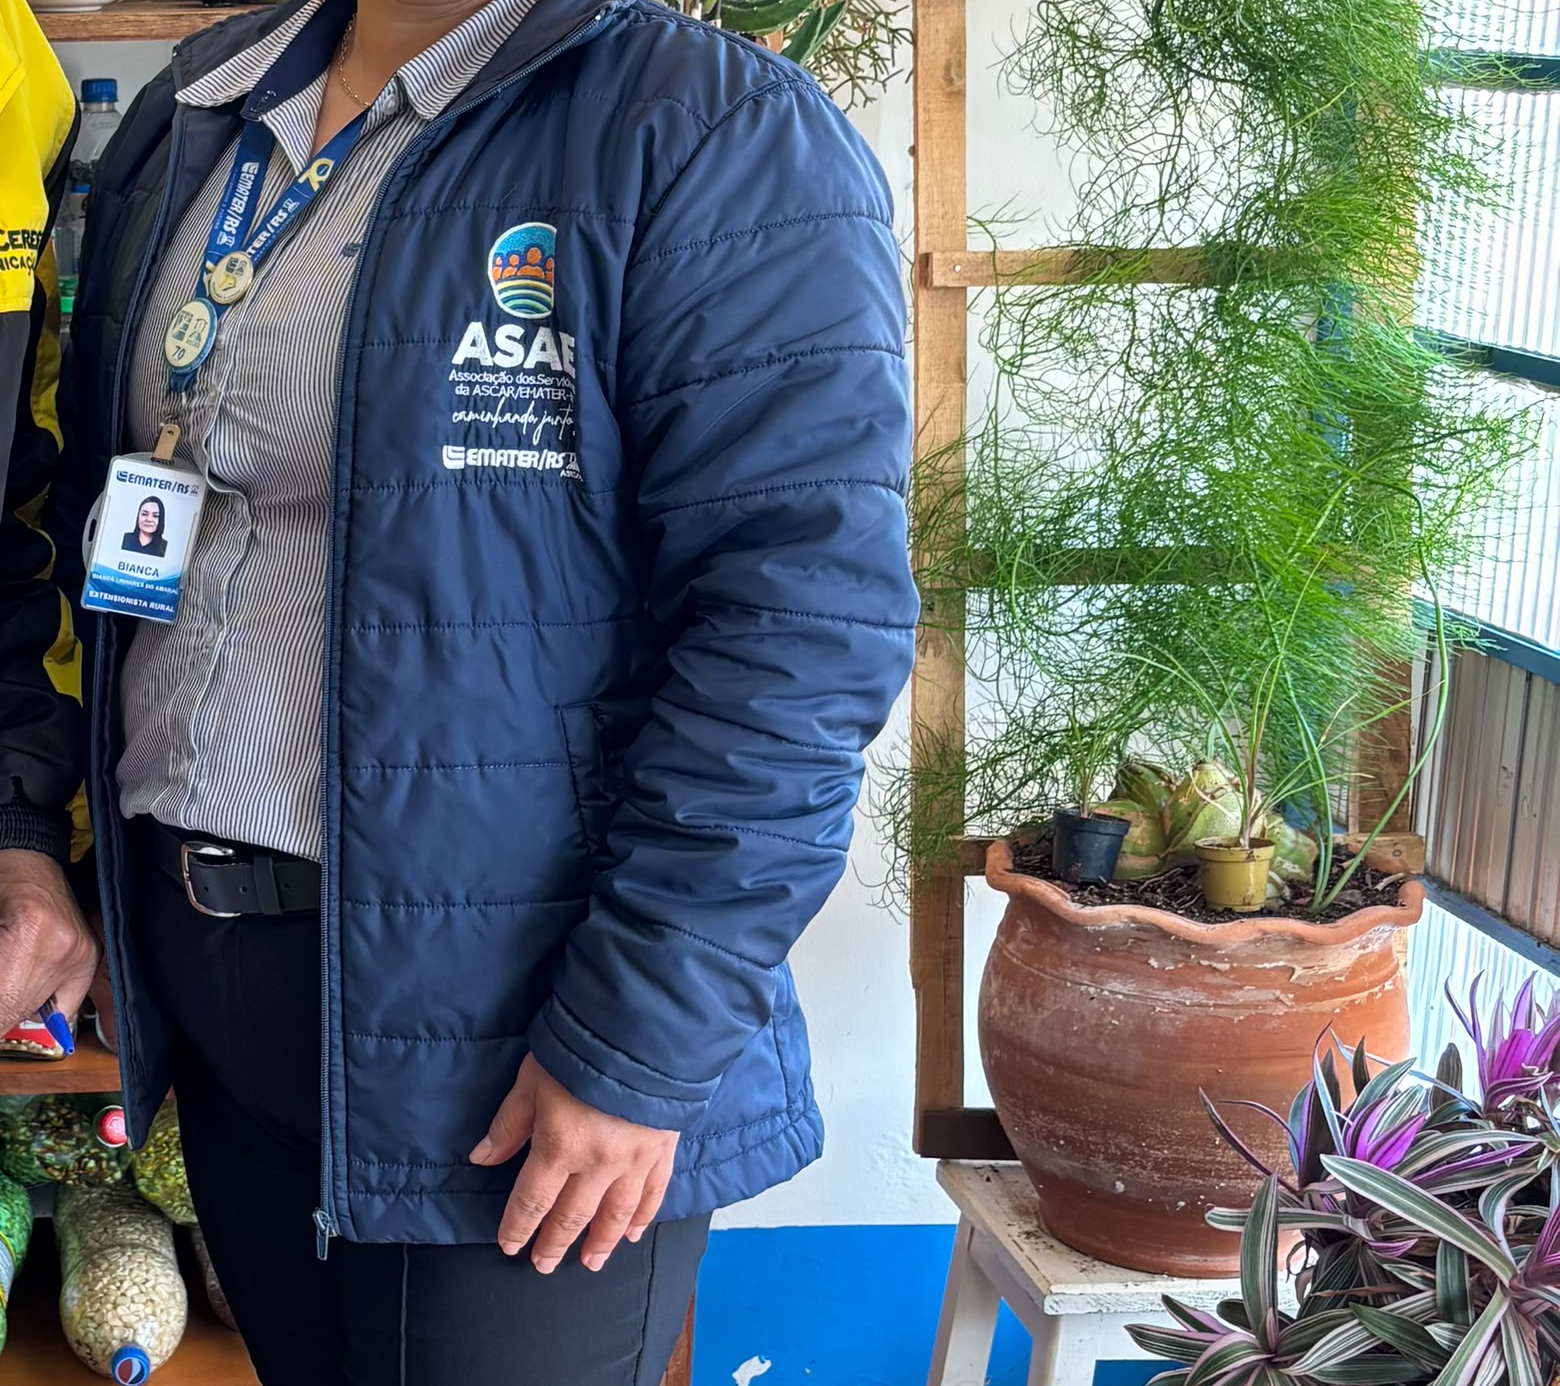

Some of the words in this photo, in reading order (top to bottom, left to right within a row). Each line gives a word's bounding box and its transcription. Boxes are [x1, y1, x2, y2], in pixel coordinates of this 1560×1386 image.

[223, 173, 255, 235] EMATER/RS
[172, 345, 186, 361] 70
[449, 369, 513, 386] Associação
[515, 373, 538, 385] dos
[455, 383, 469, 396] da
[472, 384, 574, 402] ASCAR/EMATER-
[466, 448, 564, 471] EMATER/RS
[128, 472, 190, 494] EMATER/RS
[92, 573, 115, 582] BIANCA
[118, 561, 159, 577] BIANCA
[89, 590, 148, 608] EXTENSIONISTA
[149, 601, 175, 613] RURAL
